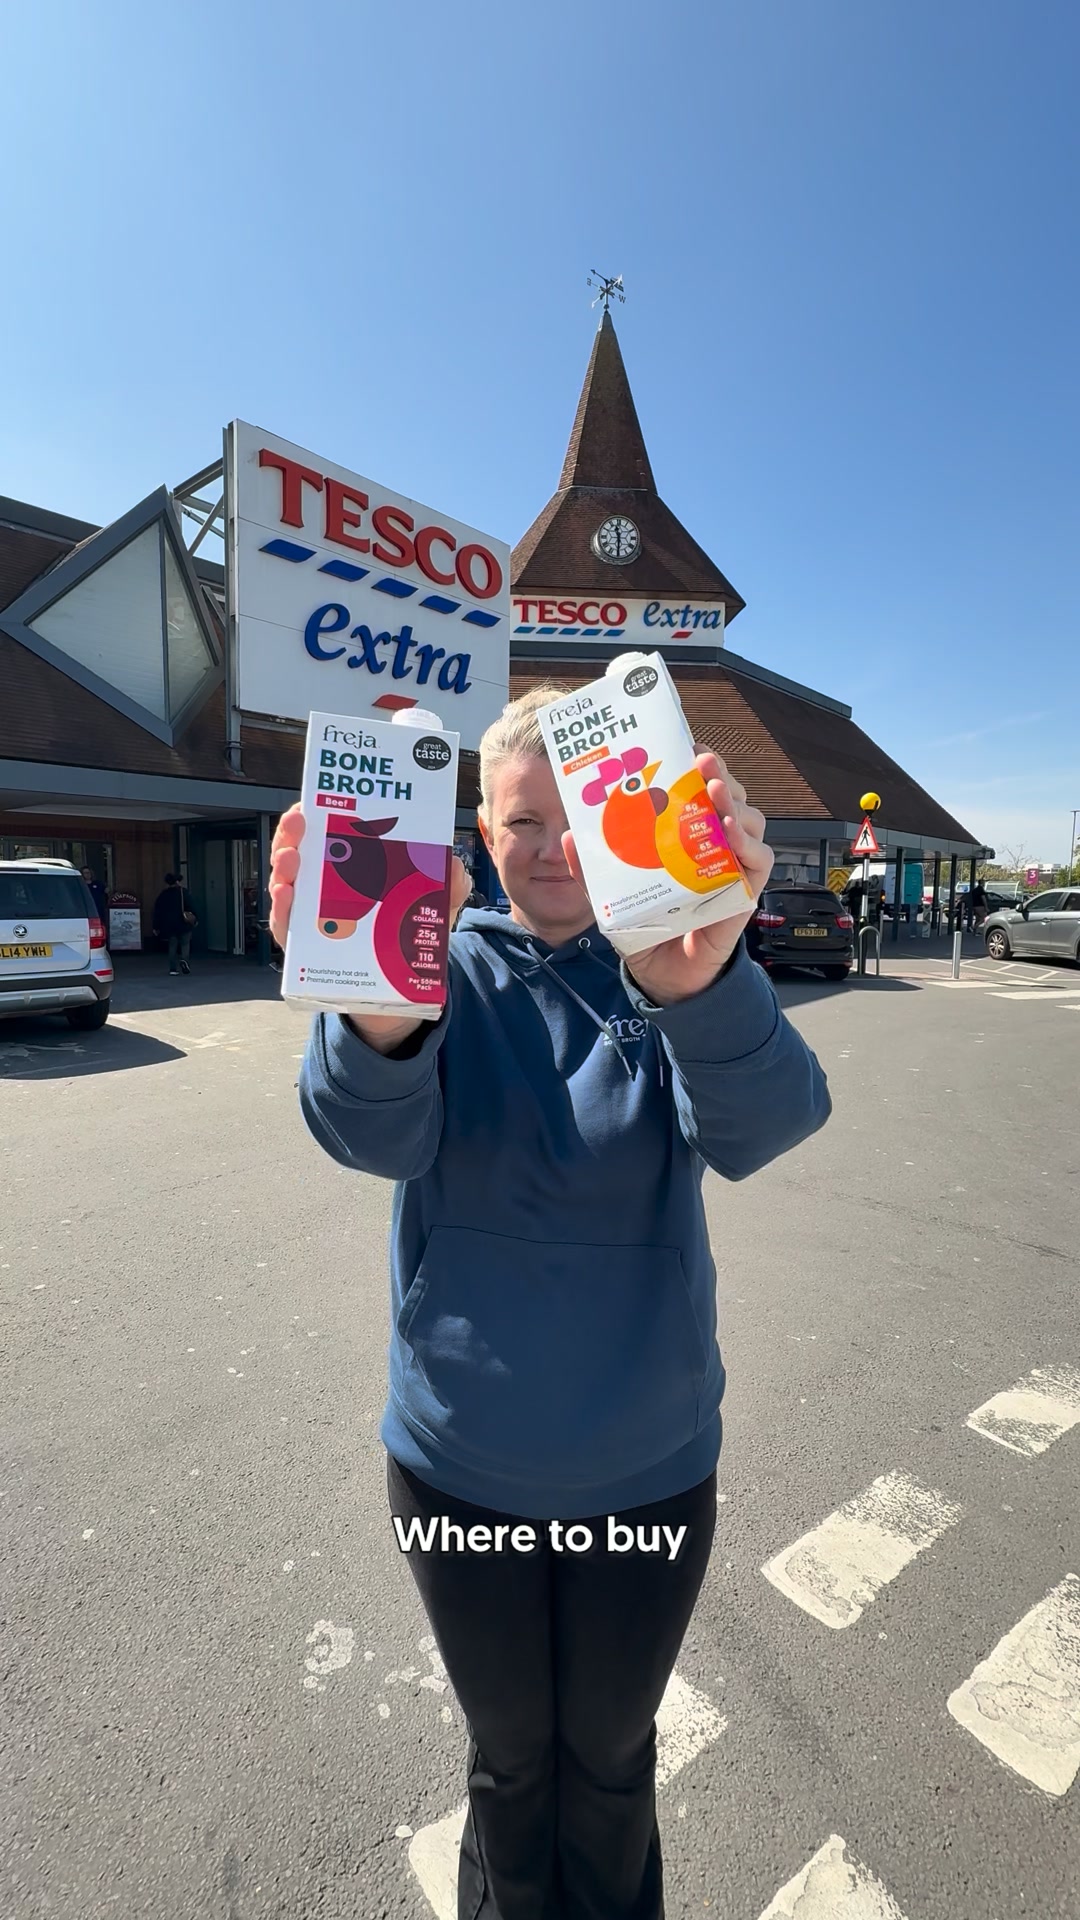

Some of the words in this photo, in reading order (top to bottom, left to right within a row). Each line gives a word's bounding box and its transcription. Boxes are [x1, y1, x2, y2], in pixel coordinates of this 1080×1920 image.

[258, 448, 502, 599] TESCO
[513, 599, 628, 626] TESCO
[643, 601, 721, 629] extra
[304, 603, 473, 694] extra
[625, 672, 657, 692] taste
[549, 697, 594, 725] freja
[553, 705, 615, 745] BONE
[323, 725, 377, 749] freja
[558, 714, 638, 763] BROTH
[423, 742, 442, 750] great
[415, 748, 449, 760] taste
[570, 752, 603, 770] Chicken
[320, 749, 394, 776] BONE
[317, 771, 412, 800] BROTH
[325, 797, 348, 808] Beef
[690, 821, 707, 832] 16g
[1029, 870, 1036, 879] 3
[420, 907, 438, 918] 18g
[418, 930, 437, 940] 25g
[23, 946, 47, 956] YWH
[419, 953, 434, 962] 110
[307, 967, 341, 978] Nourishing
[306, 976, 334, 984] Premium
[335, 978, 360, 987] cooking
